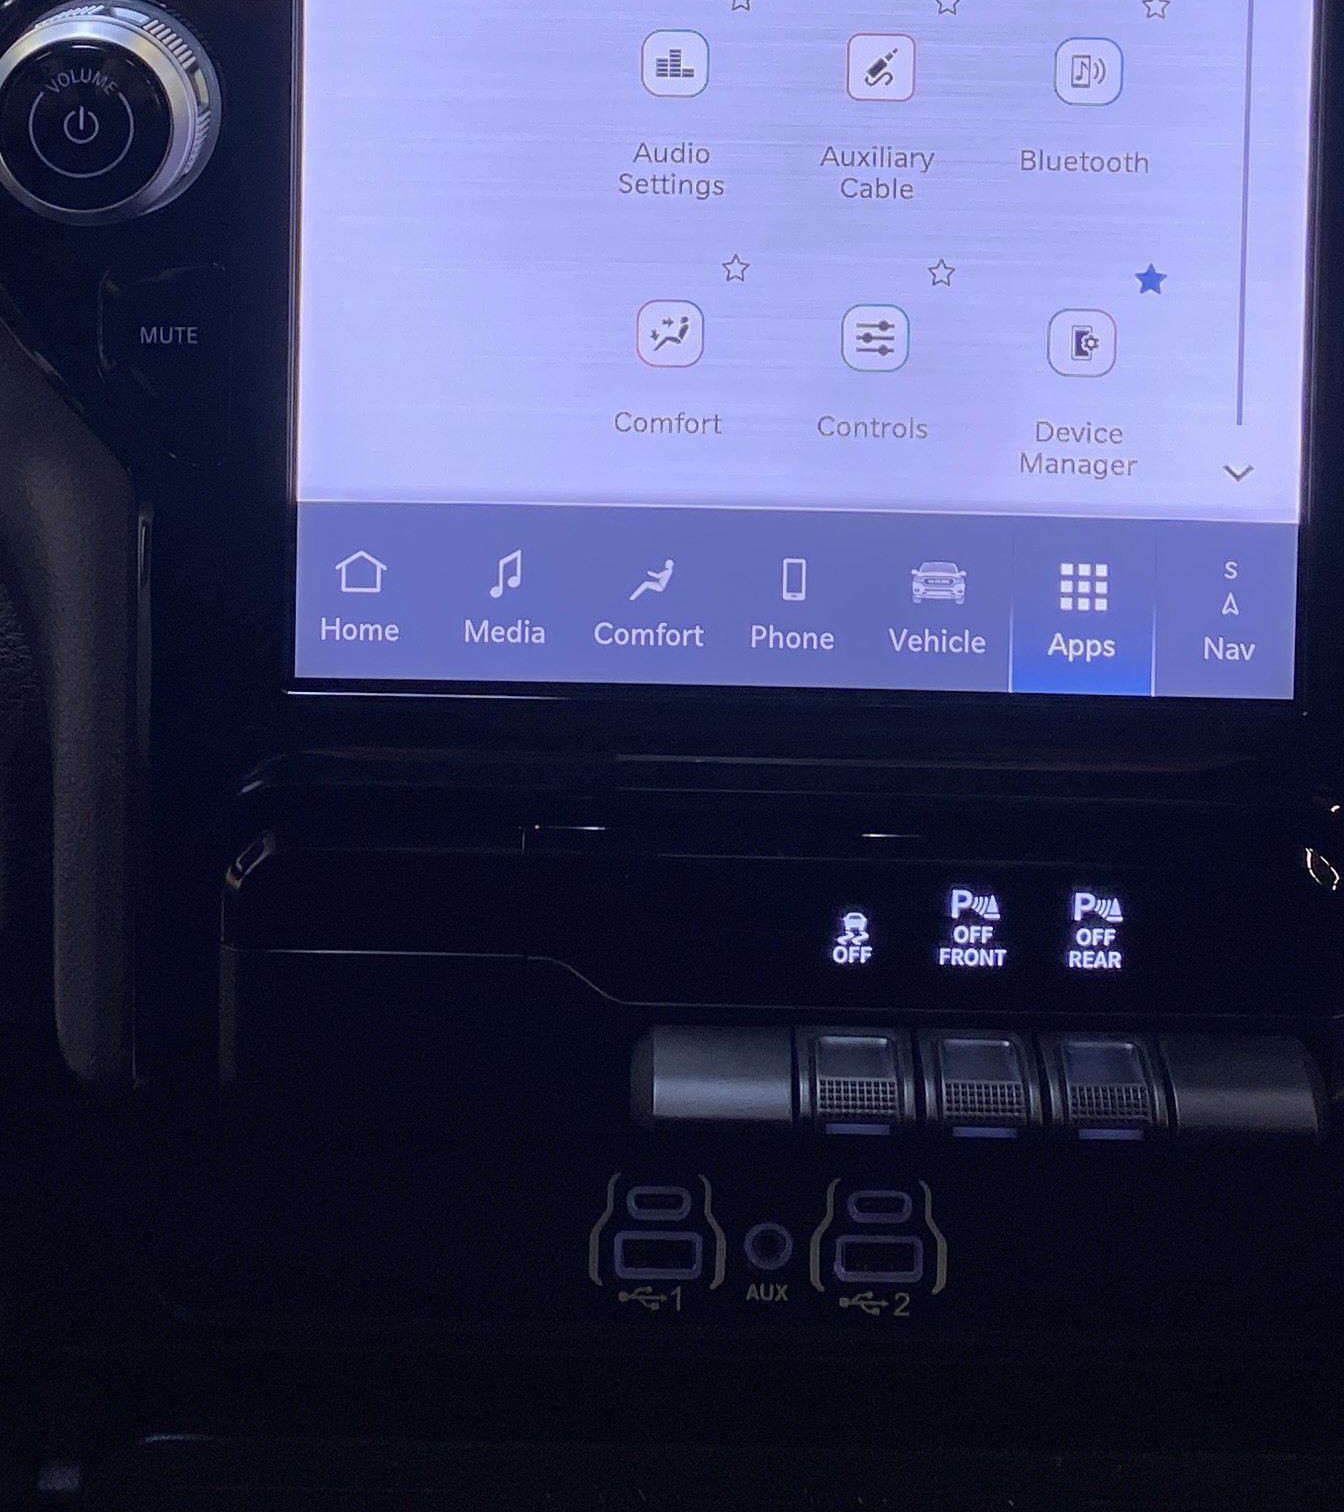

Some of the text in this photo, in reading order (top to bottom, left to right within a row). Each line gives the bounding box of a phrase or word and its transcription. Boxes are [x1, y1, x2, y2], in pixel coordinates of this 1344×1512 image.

[45, 71, 118, 96] VOLUME
[632, 142, 711, 164] Audio
[820, 146, 935, 175] Auxiliary
[1019, 149, 1150, 174] Bluetooth
[618, 173, 725, 199] Settings
[840, 177, 914, 201] Cable
[140, 326, 198, 345] MUTE
[614, 411, 722, 435] Comfort
[817, 415, 929, 440] Controls
[1035, 420, 1124, 445] Device
[1019, 452, 1138, 480] Manager
[1224, 562, 1237, 580] S
[320, 617, 400, 644] Home
[464, 619, 546, 646] Media
[594, 621, 704, 649] Comfort
[750, 624, 834, 652] Phone
[888, 628, 987, 656] Vehicle
[1048, 633, 1115, 663] Apps
[1203, 637, 1256, 661] Nav
[953, 925, 994, 944] OFF
[1076, 928, 1116, 946] OFF
[832, 945, 872, 964] OFF
[939, 948, 1006, 968] FRONT
[1068, 950, 1122, 970] REAR
[670, 1289, 683, 1311] 1
[746, 1284, 789, 1303] AUX
[893, 1293, 911, 1317] 2
